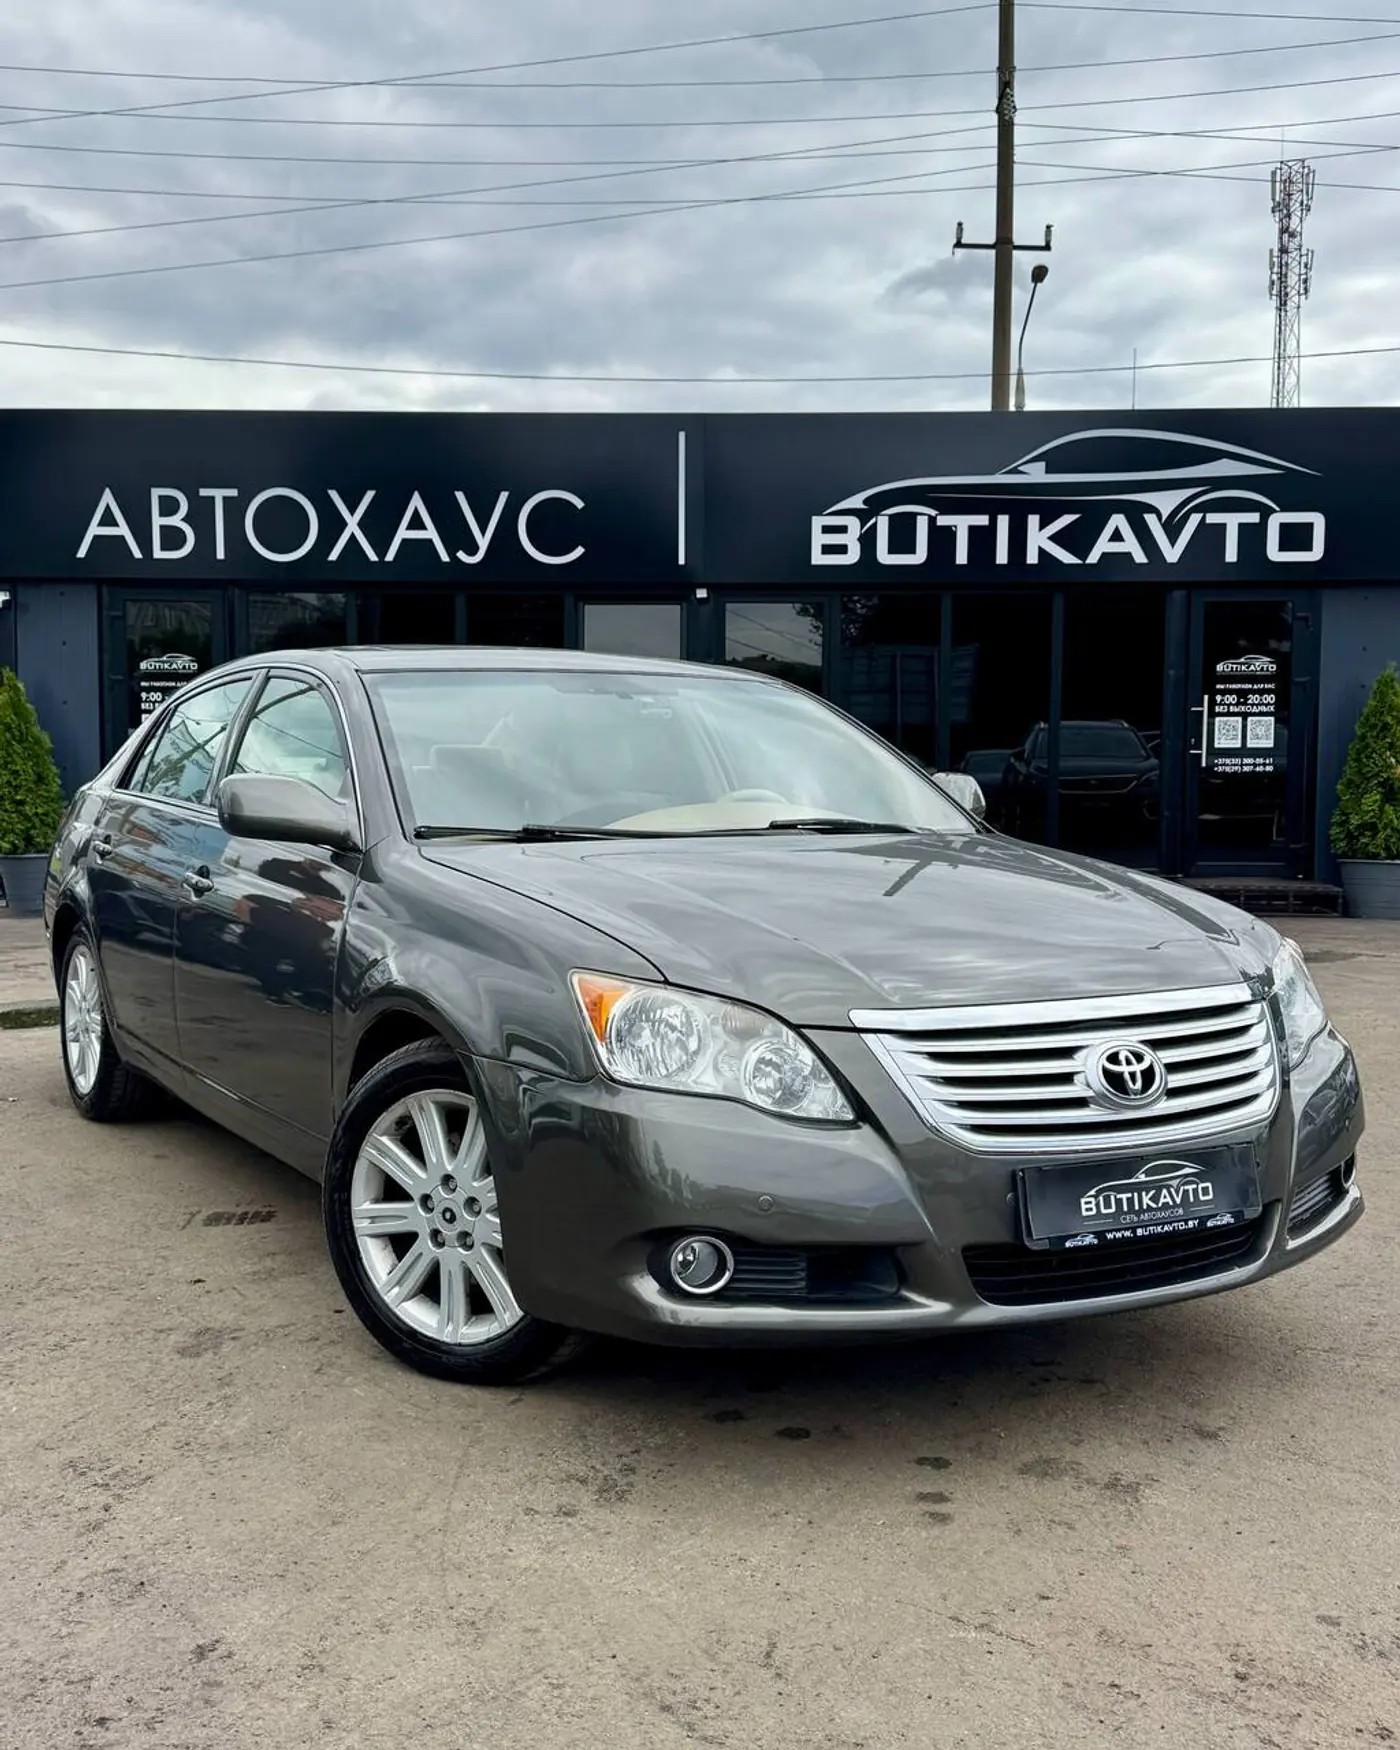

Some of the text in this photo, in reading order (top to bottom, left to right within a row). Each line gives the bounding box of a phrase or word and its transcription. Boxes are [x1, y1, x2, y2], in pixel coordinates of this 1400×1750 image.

[76, 487, 586, 564] АВТОХАУС
[810, 510, 1325, 566] BUTIKAVTO
[1216, 663, 1277, 672] BUTIKAVTO
[140, 692, 163, 701] 9:00
[1215, 694, 1238, 704] 9:00
[1246, 694, 1276, 704] 20:00
[1229, 705, 1276, 713] ВЫХОДНЫХ
[1079, 1182, 1214, 1217] BUTIKAVTO
[1119, 1214, 1138, 1224] СЕТЬ
